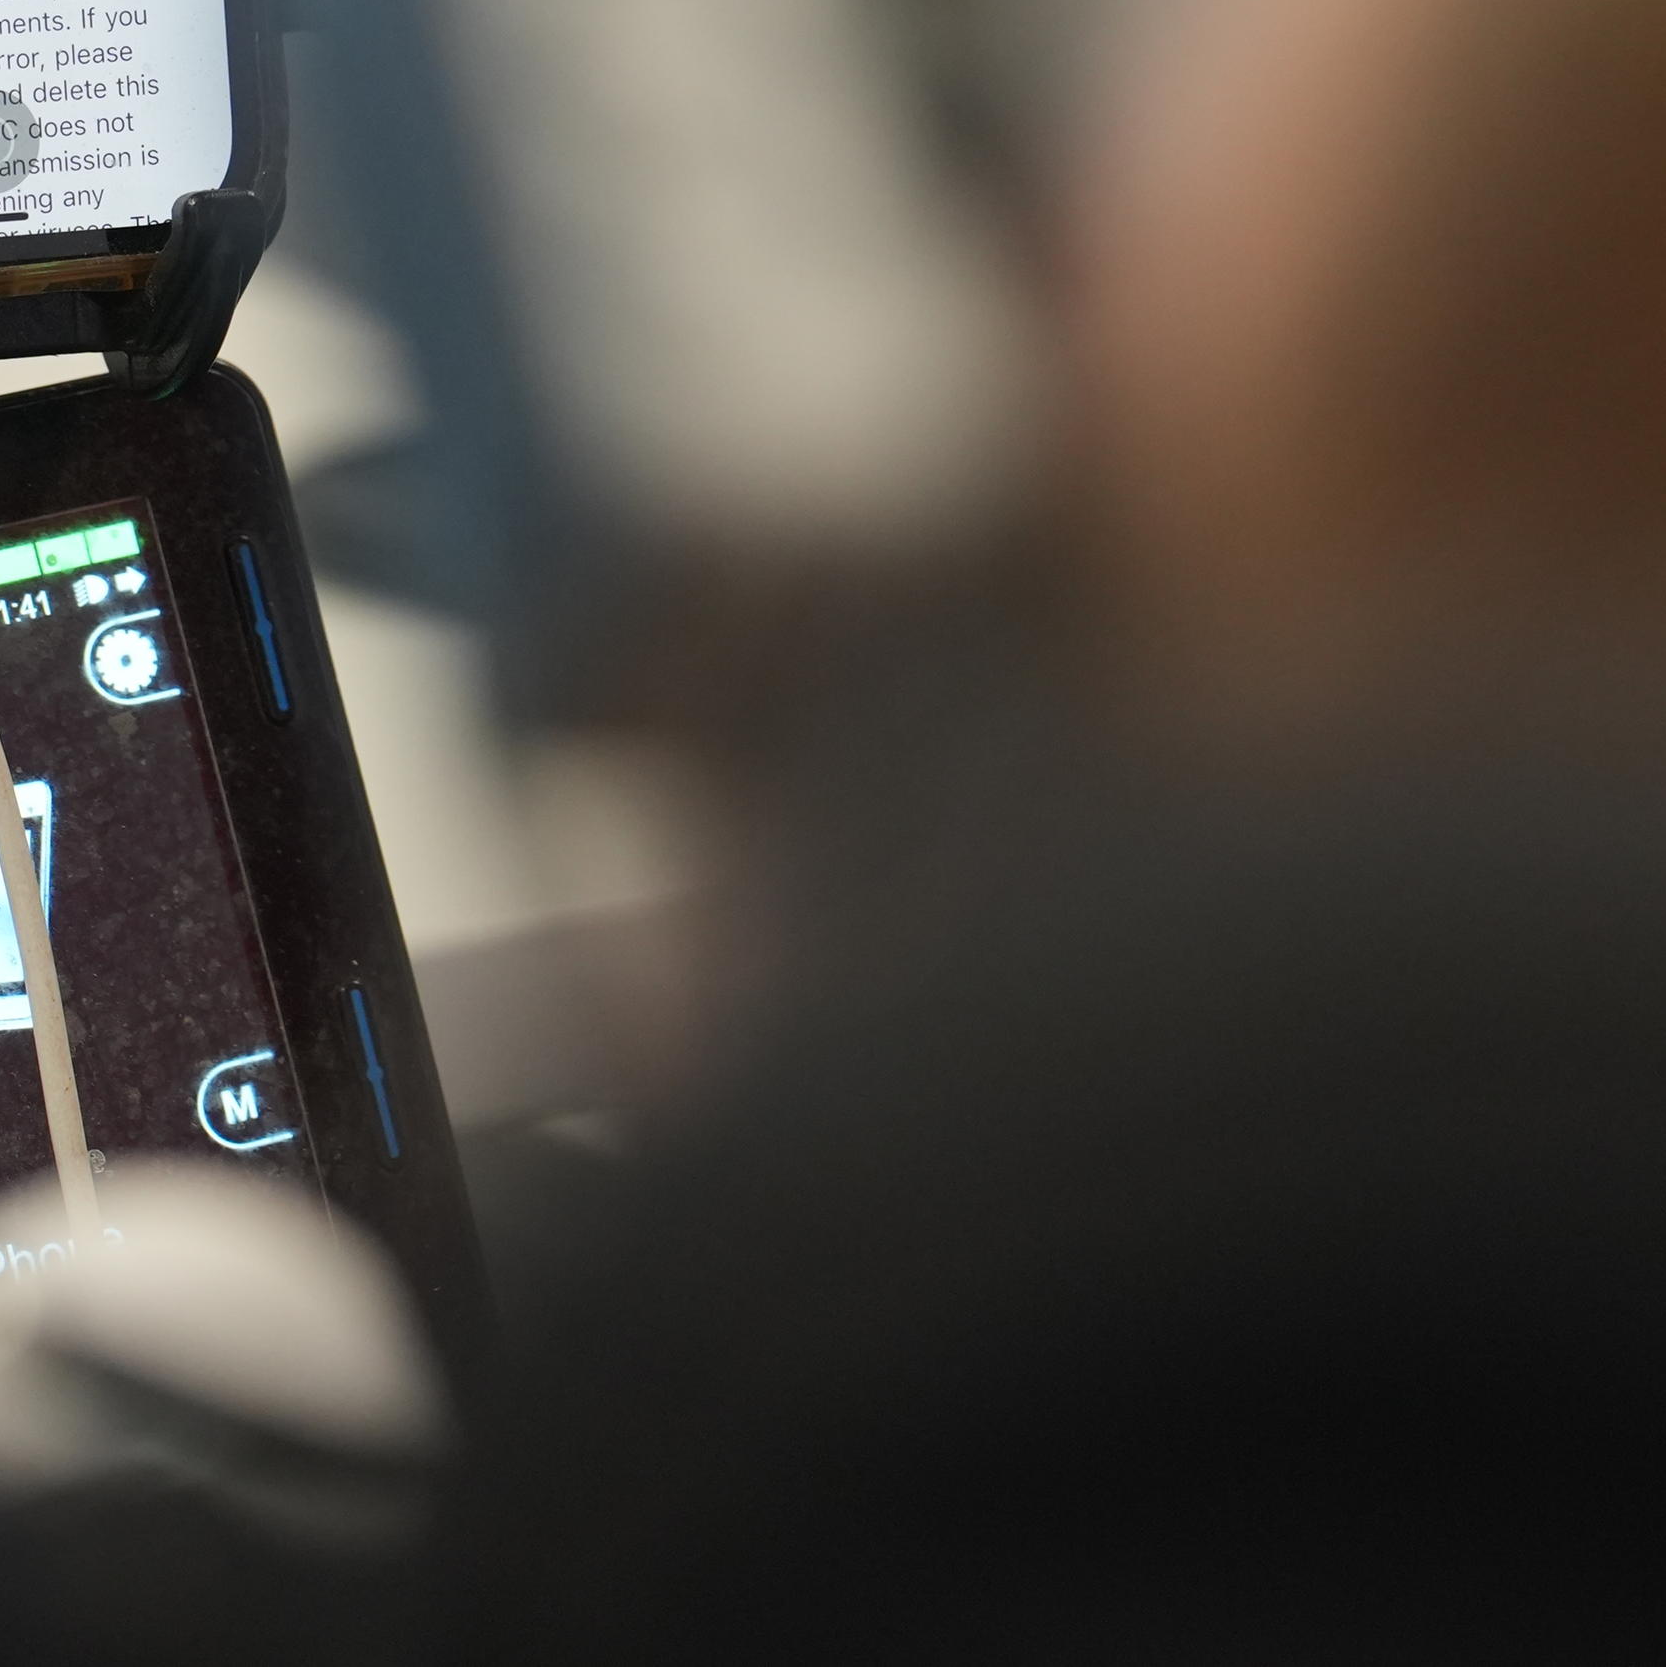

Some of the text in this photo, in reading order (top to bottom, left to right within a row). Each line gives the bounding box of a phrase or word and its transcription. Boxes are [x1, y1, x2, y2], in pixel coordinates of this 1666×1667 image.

[32, 79, 107, 104] delete
[114, 72, 162, 100] this
[219, 1083, 259, 1125] M
